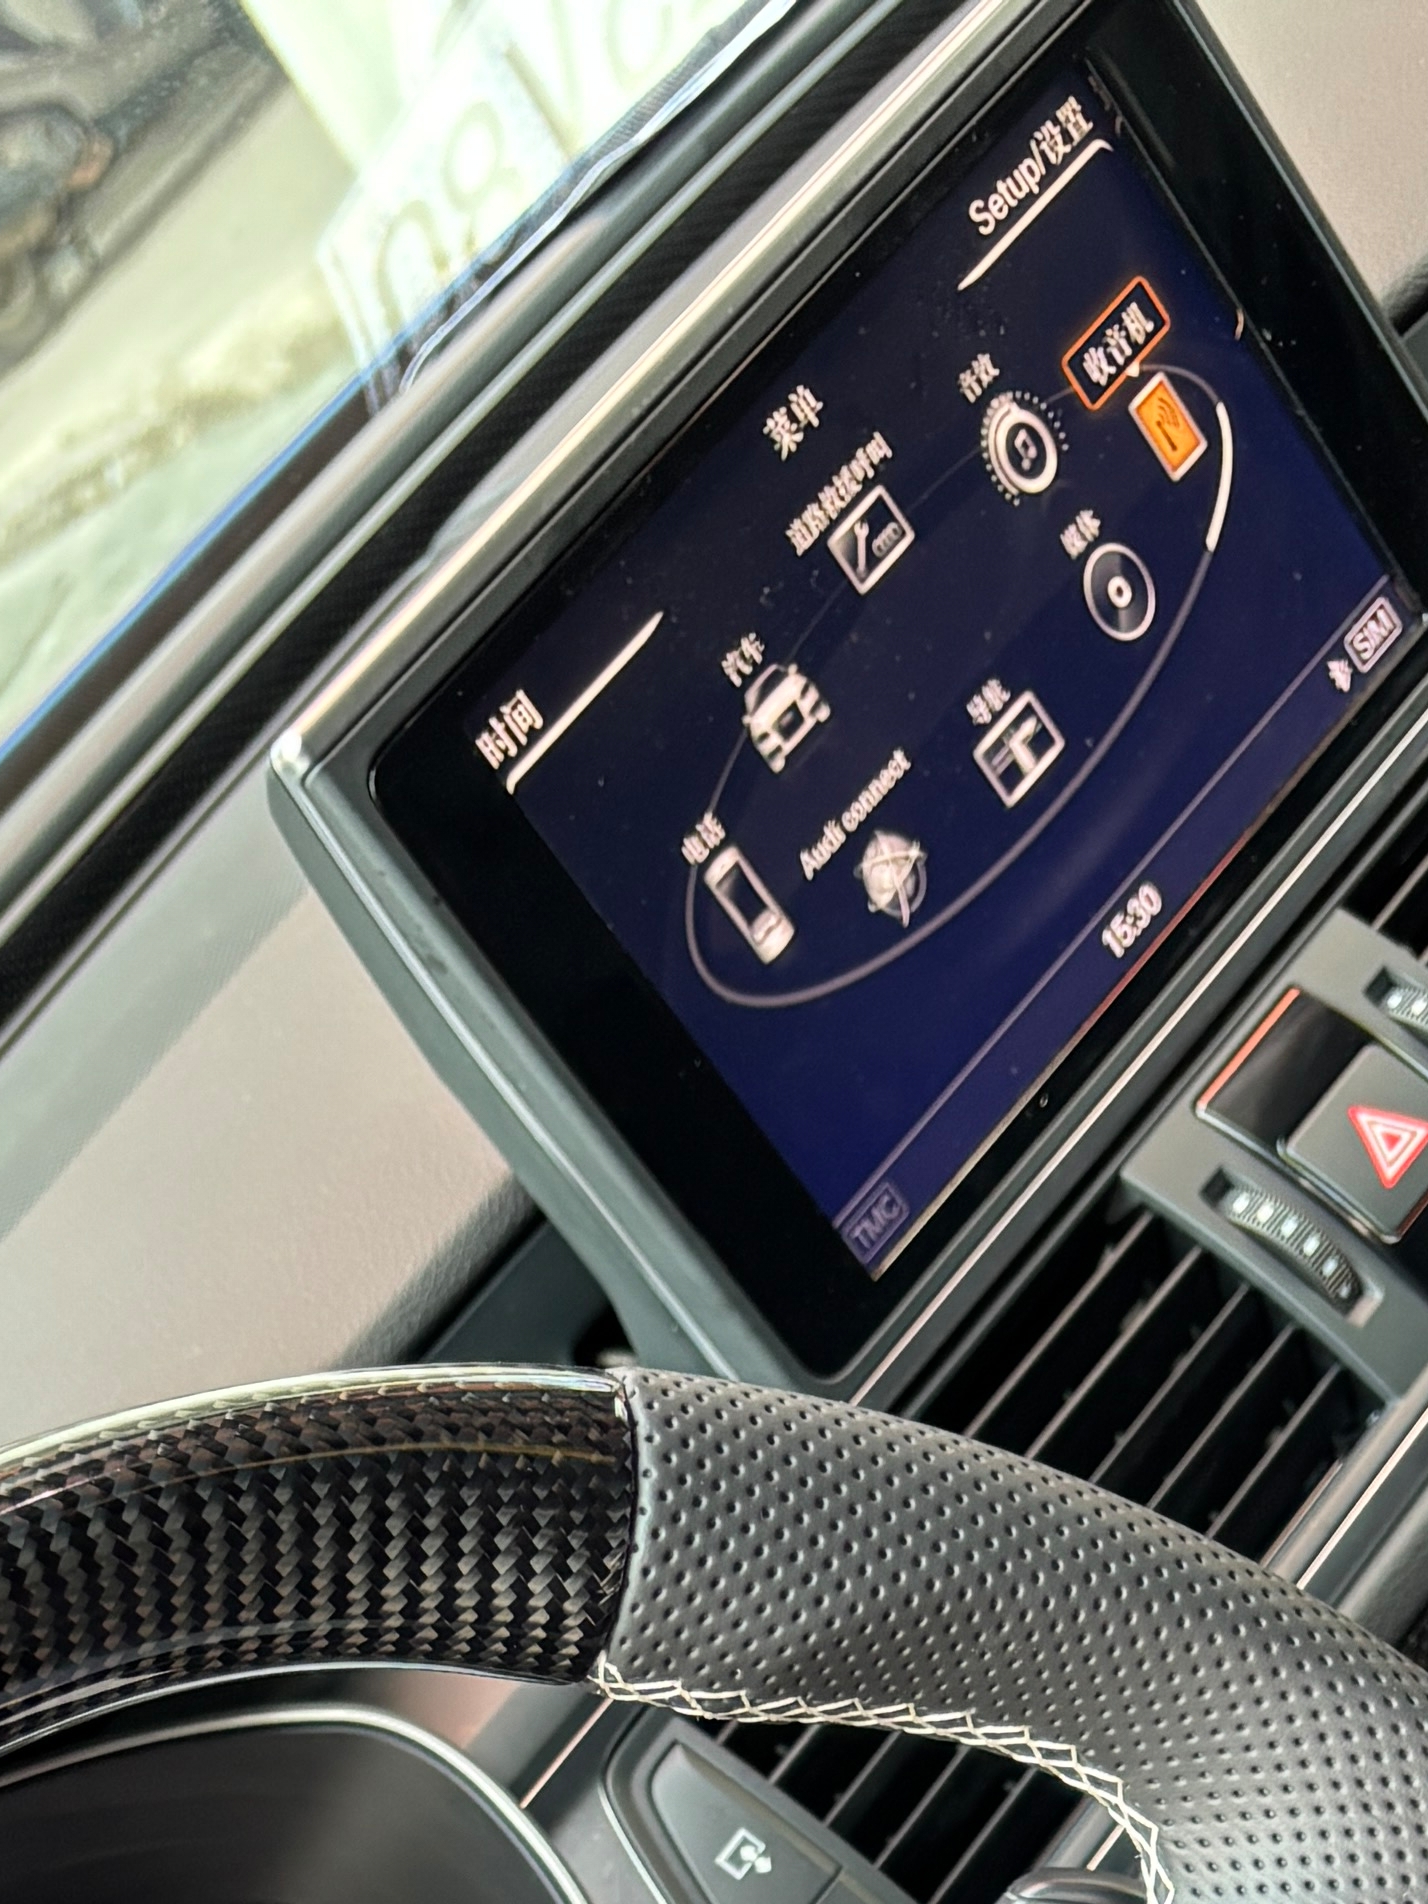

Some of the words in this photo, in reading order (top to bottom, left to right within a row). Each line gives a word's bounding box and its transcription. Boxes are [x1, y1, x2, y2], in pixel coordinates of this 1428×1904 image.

[960, 354, 999, 402] 音效
[1083, 302, 1154, 385] 收音机
[763, 385, 823, 460] 菜单
[722, 633, 764, 687] 汽车
[476, 690, 543, 769] 时间
[682, 811, 725, 864] 电话
[800, 820, 846, 880] Audi
[842, 749, 911, 831] connect
[1102, 884, 1161, 957] 15:30
[850, 1195, 899, 1247] TMC
